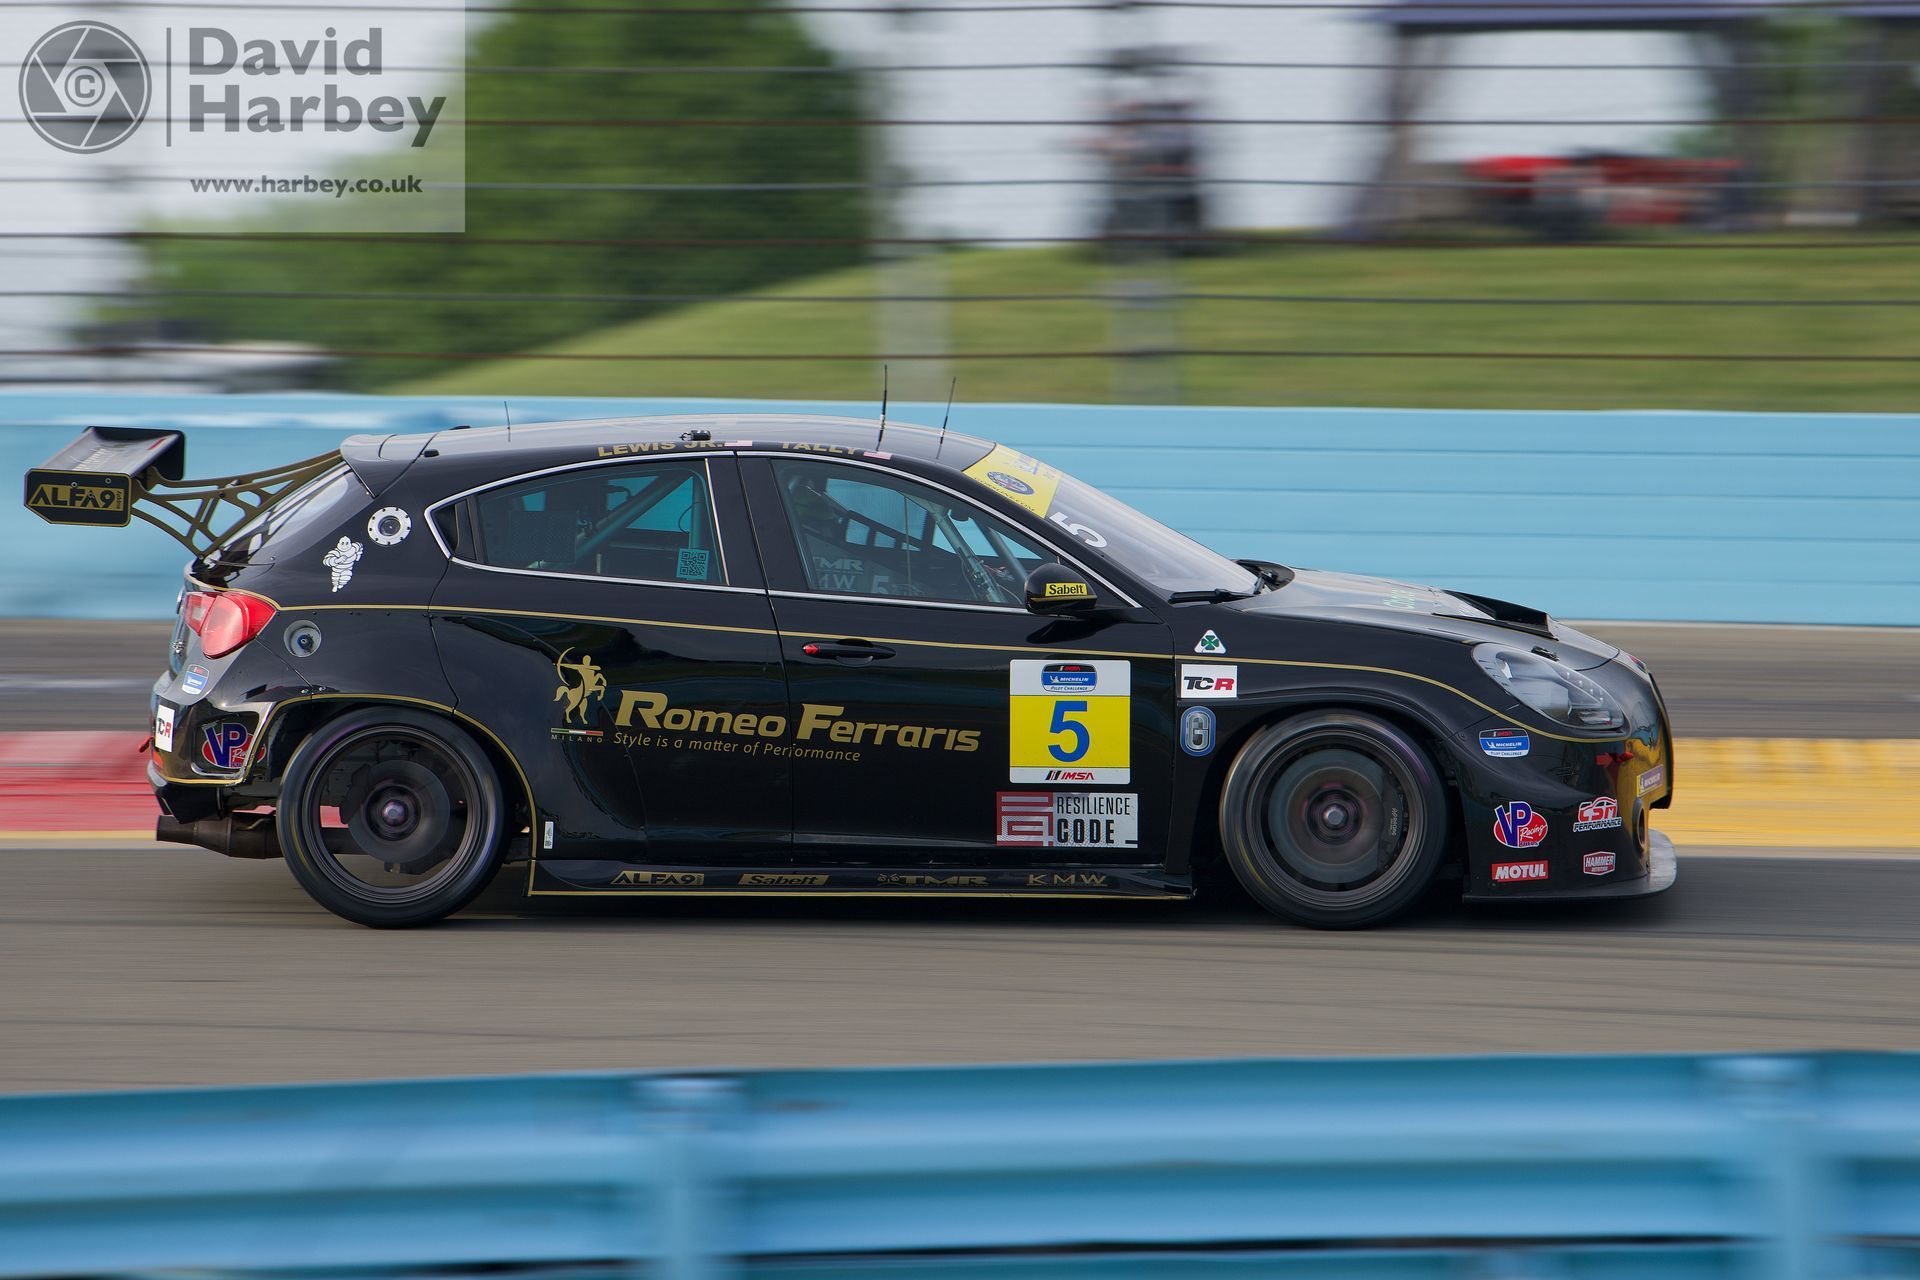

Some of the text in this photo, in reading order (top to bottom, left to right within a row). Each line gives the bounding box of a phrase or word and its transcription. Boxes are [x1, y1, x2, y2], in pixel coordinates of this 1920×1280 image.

[597, 441, 676, 457] LEWIS
[781, 441, 855, 455] TALLY
[31, 486, 115, 509] ALFA9
[1049, 511, 1108, 548] 5
[1048, 584, 1084, 595] Sabelt
[1183, 676, 1235, 690] TCR
[551, 734, 603, 744] MILANO
[1047, 700, 1091, 763] 5
[613, 732, 861, 762] Style is a matter of Performance
[1060, 772, 1095, 780] IMSA
[1056, 796, 1131, 815] RESILIENCE
[1056, 818, 1115, 844] CODE
[1494, 801, 1533, 848] VP
[1519, 823, 1548, 840] Racing
[1585, 855, 1615, 868] HAMMER
[614, 872, 697, 885] ALFA9
[1494, 863, 1547, 880] MOTUL
[751, 875, 818, 886] Sabelt
[899, 875, 990, 886] TMR
[1026, 873, 1107, 886] KMW
